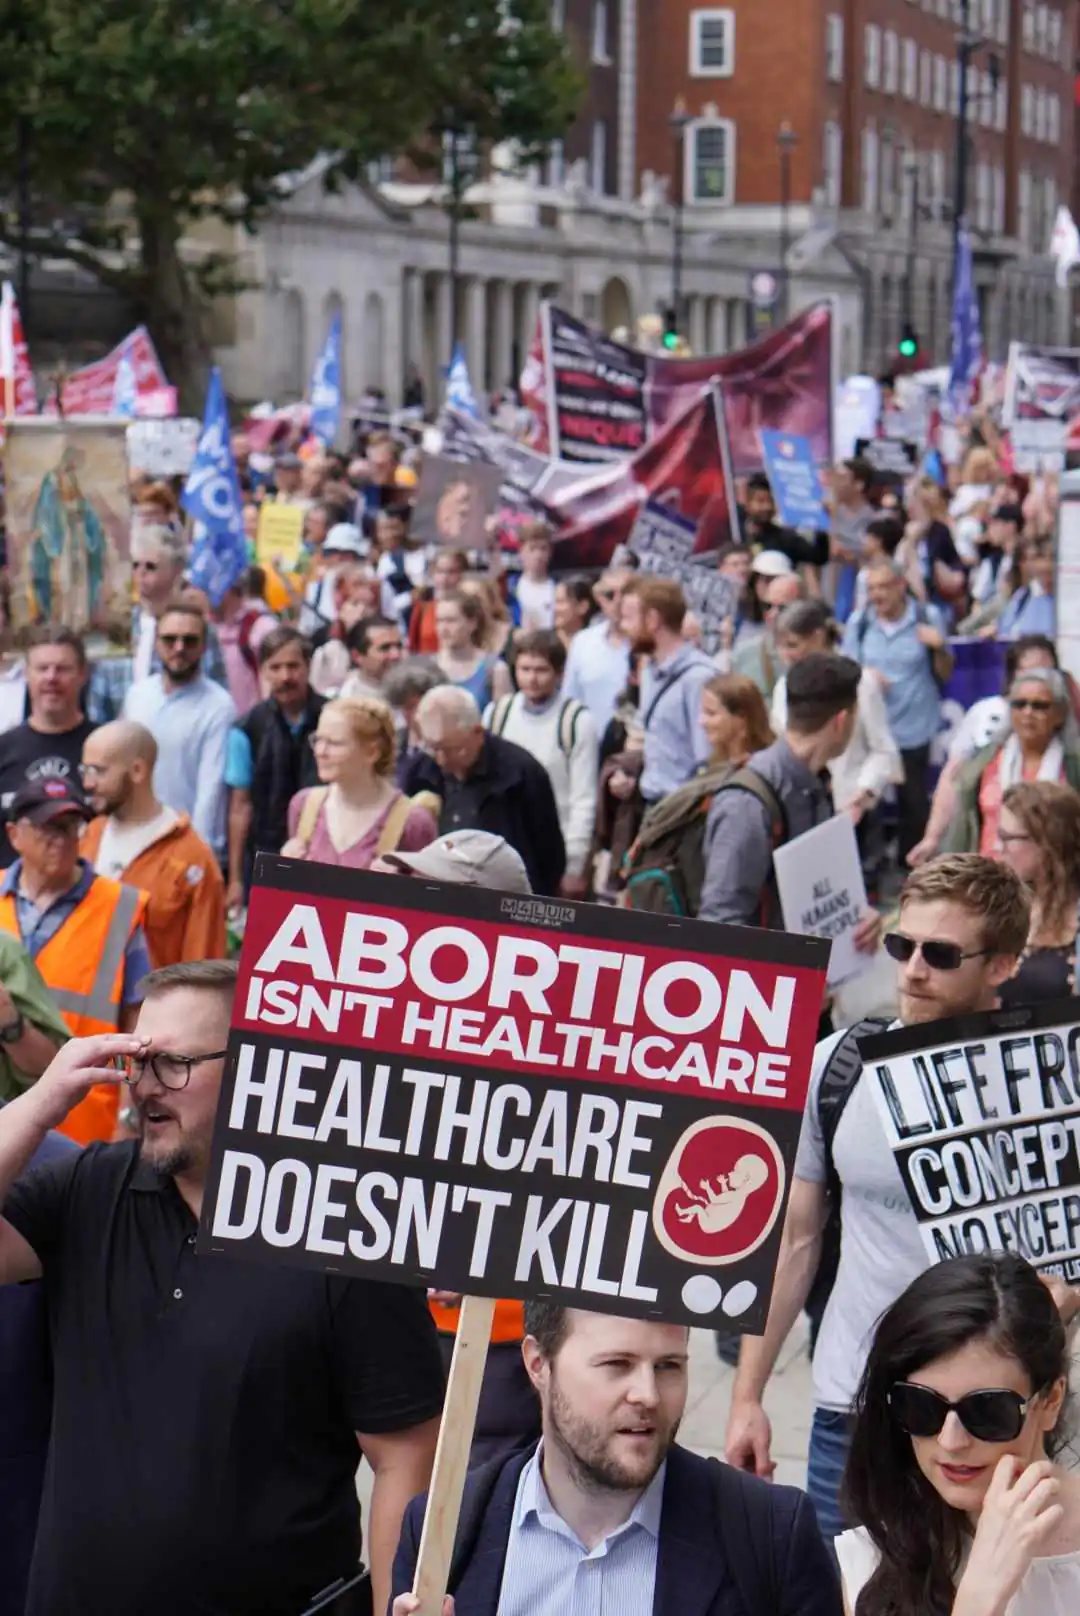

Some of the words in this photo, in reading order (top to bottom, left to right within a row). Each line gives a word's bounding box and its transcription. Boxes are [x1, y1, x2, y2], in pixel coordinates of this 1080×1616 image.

[245, 977, 393, 1038] ISN'T
[402, 1001, 791, 1098] HEALTHCARE
[254, 904, 796, 1048] ABORTION
[229, 1044, 662, 1188] HEALTHCARE
[875, 1043, 999, 1140] LIFE
[212, 1150, 512, 1277] DOESN'T
[515, 1195, 658, 1301] KILL
[931, 1218, 991, 1261] NO
